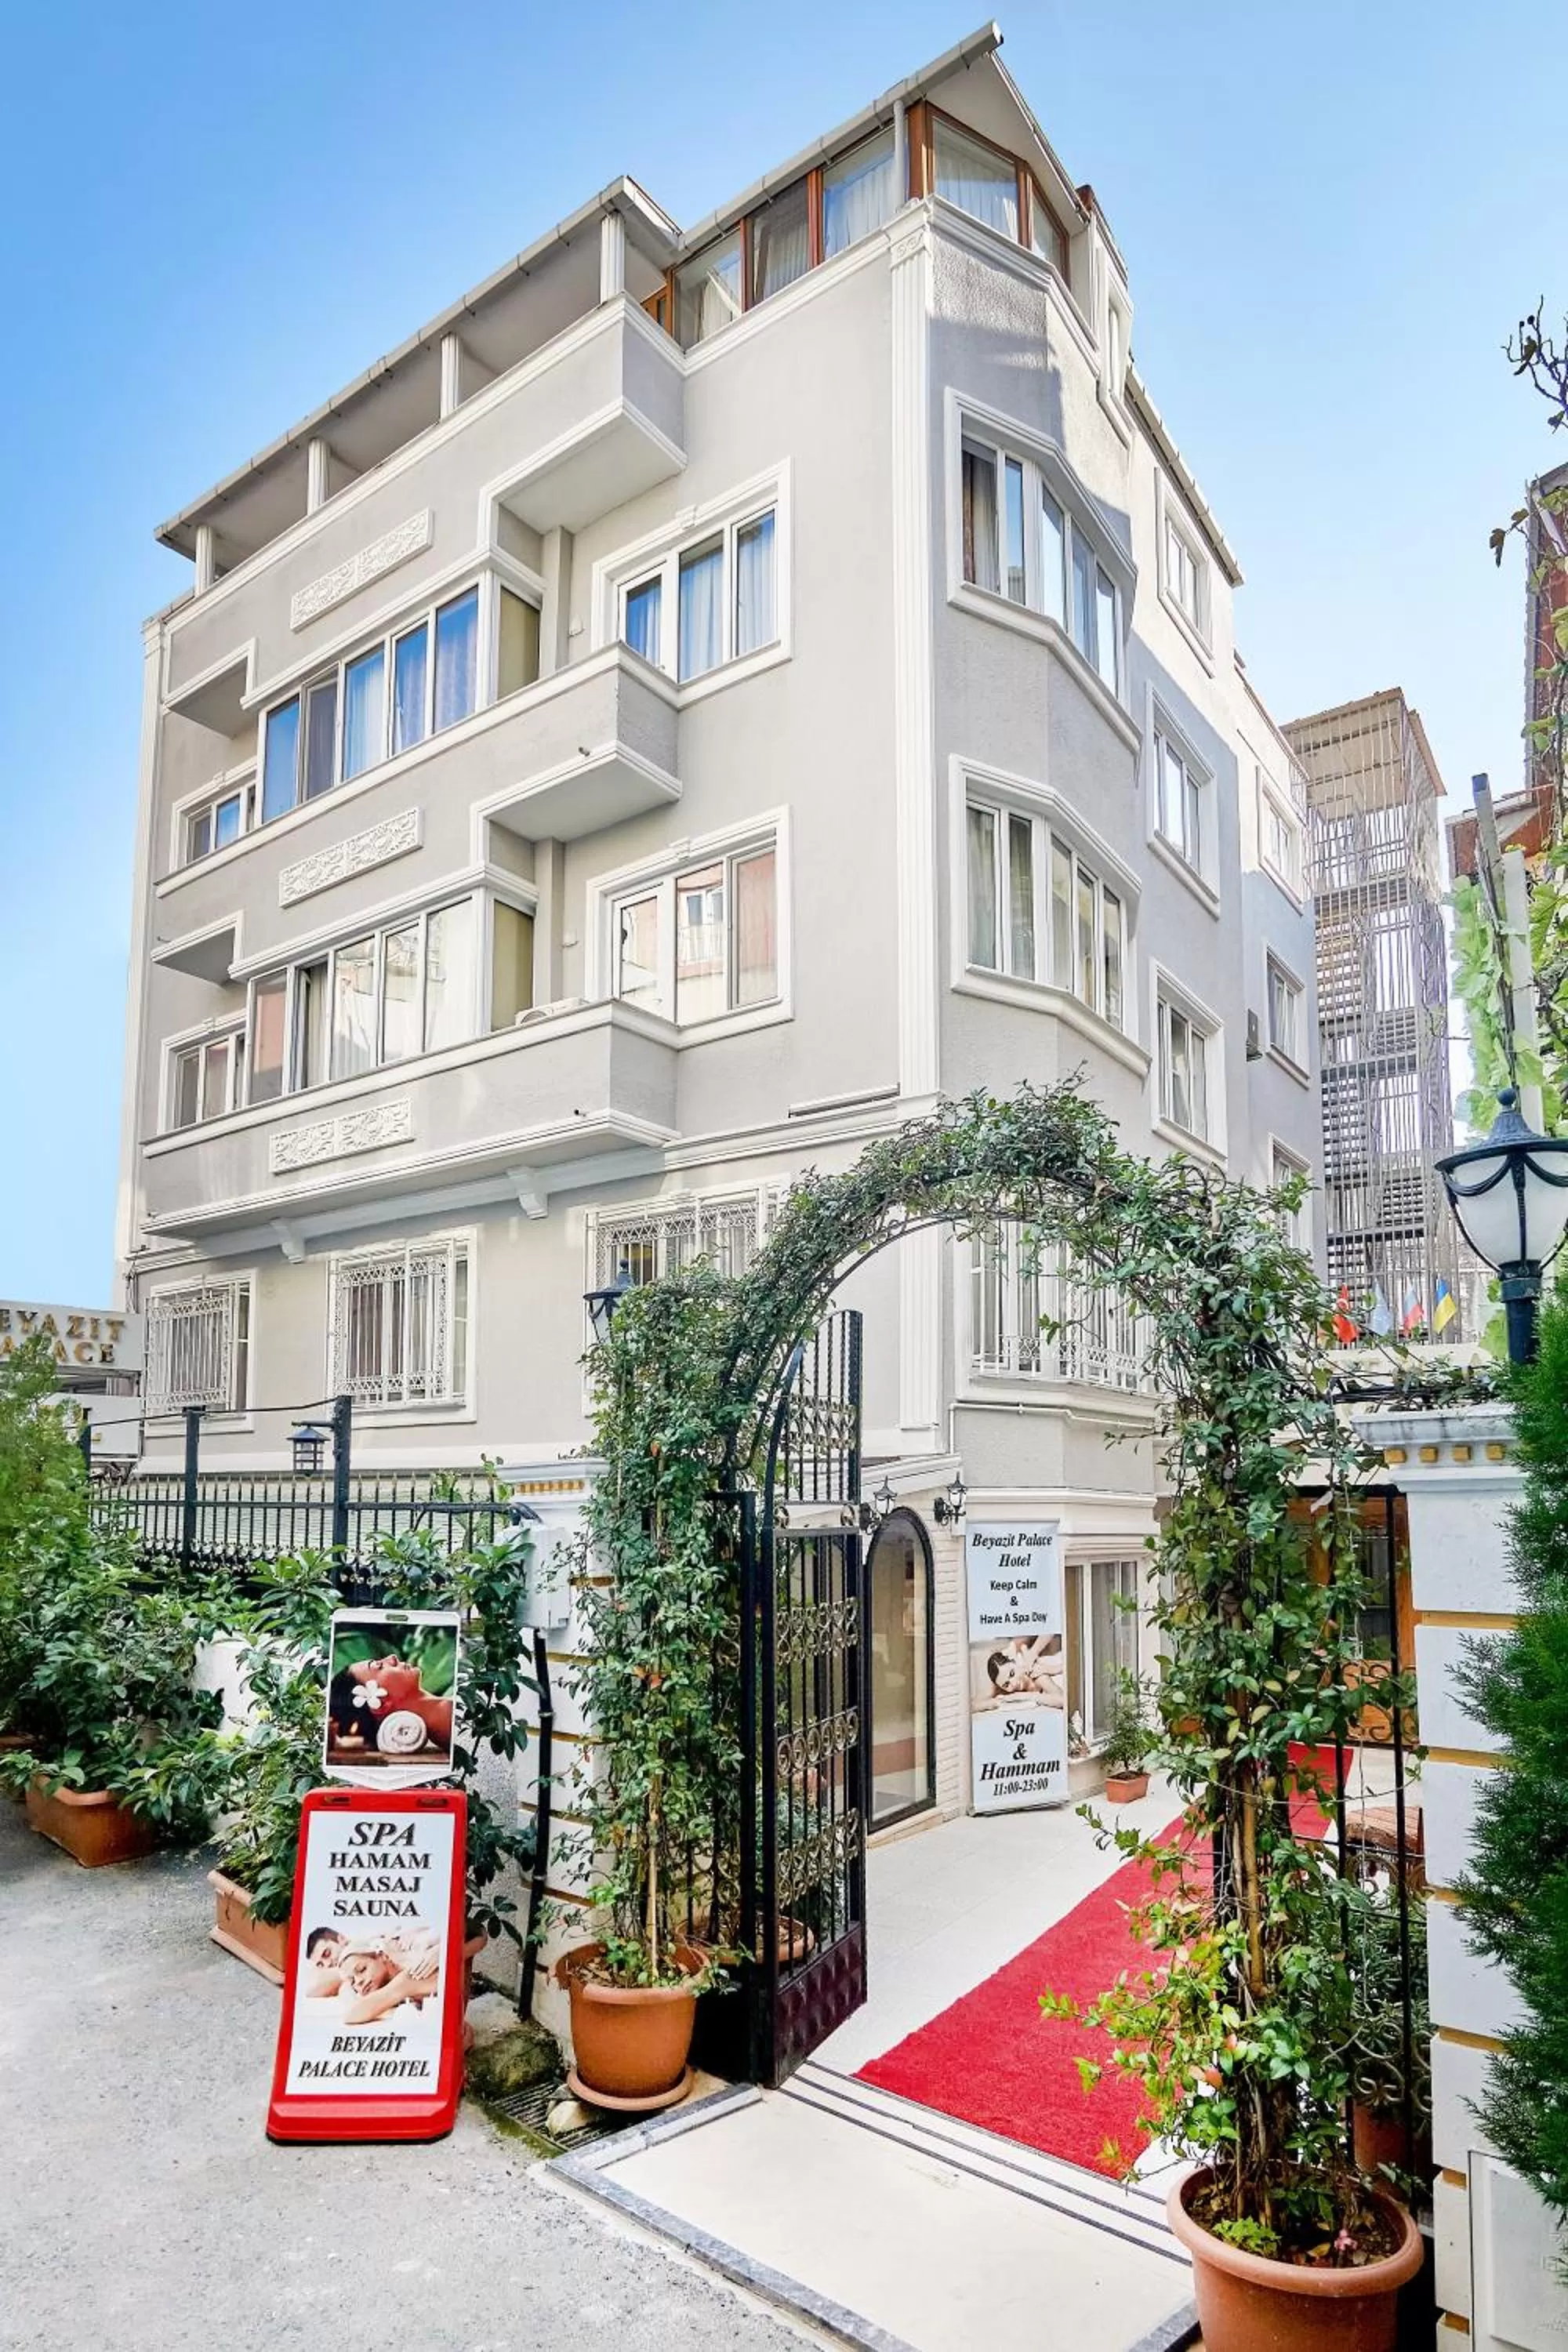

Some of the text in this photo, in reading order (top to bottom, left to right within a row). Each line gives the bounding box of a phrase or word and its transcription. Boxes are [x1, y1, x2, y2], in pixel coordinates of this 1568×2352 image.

[0, 1335, 115, 1363] AACE
[972, 1533, 1053, 1550] Beyazit Palace
[998, 1553, 1032, 1567] Hotel
[990, 1579, 1037, 1592] Keep Calm
[1010, 1595, 1018, 1606] &
[980, 1612, 1047, 1624] Have A Spa Day
[1004, 1719, 1036, 1740] Spa
[1013, 1743, 1027, 1759] &
[980, 1760, 1060, 1781] Hammam
[348, 1822, 416, 1846] SPA
[328, 1852, 432, 1870] HAMAM
[336, 1876, 423, 1893] MASAJ
[333, 1900, 420, 1917] SAUNA
[298, 2060, 430, 2078] PALACE HOTEL
